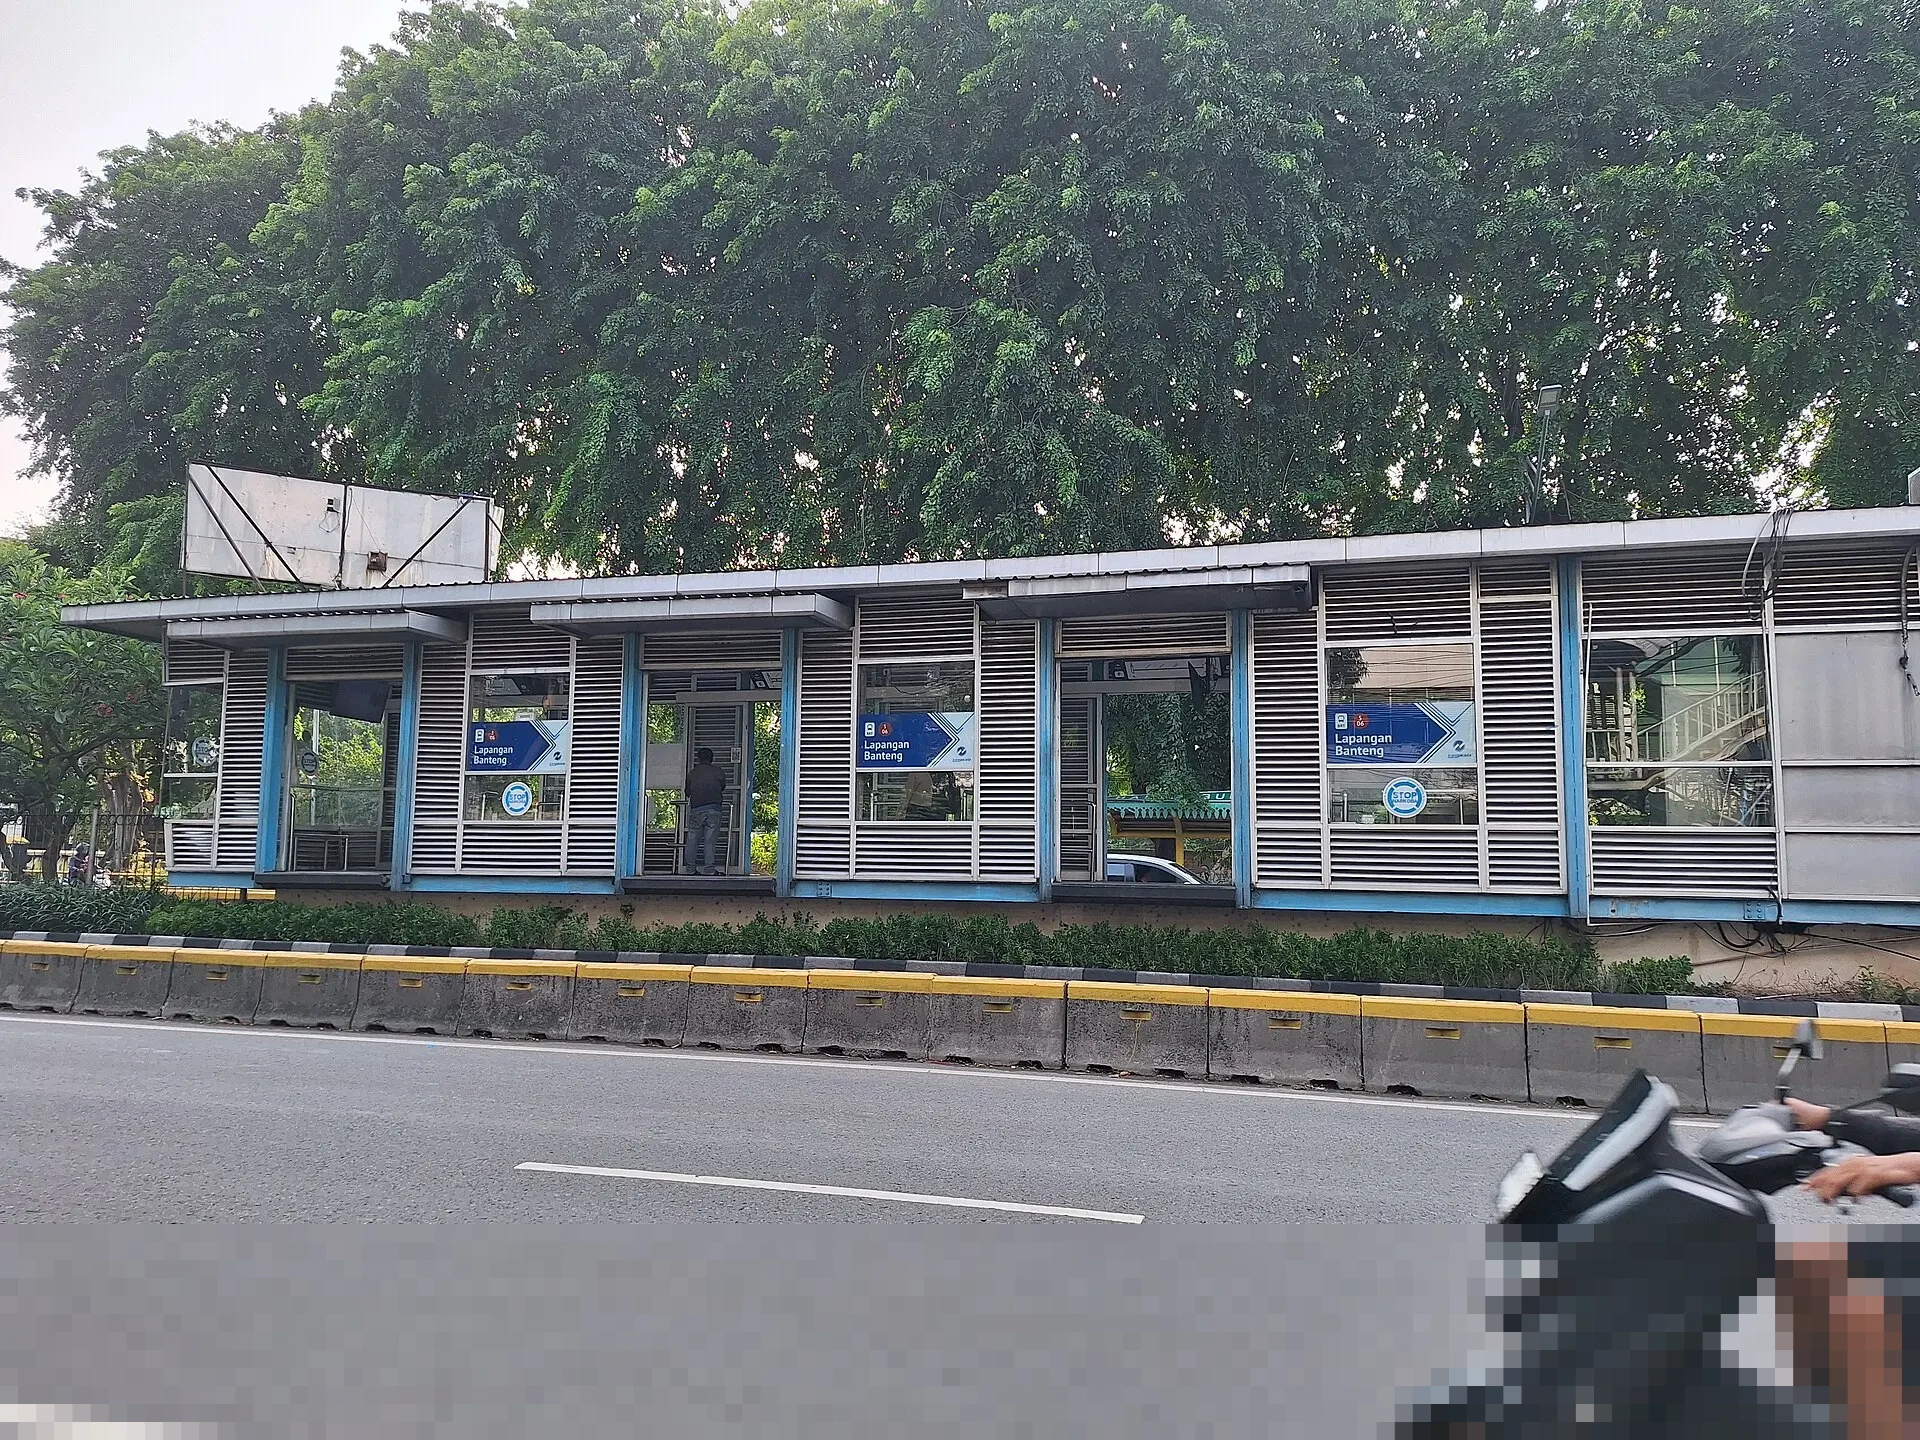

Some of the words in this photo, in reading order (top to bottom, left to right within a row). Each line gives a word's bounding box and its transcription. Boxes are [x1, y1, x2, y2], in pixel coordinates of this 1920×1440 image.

[1335, 734, 1392, 745] Lapangan
[474, 745, 513, 756] Lapangan
[864, 740, 910, 751] Lapangan
[864, 751, 903, 762] Banteng
[1335, 746, 1384, 758] Banteng
[473, 756, 507, 766] Banteng
[1392, 791, 1417, 799] STOP
